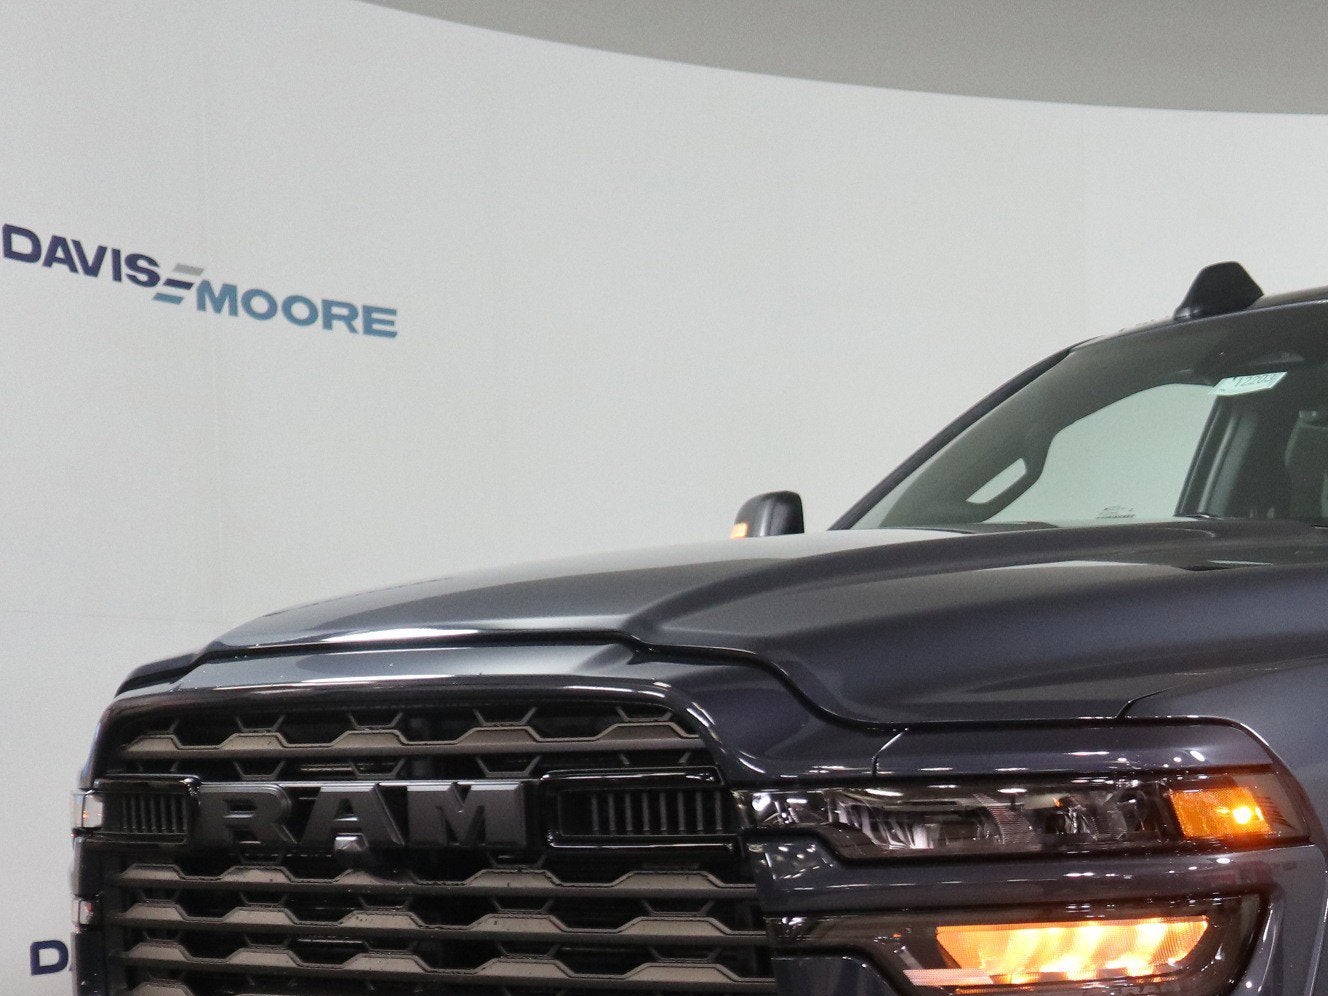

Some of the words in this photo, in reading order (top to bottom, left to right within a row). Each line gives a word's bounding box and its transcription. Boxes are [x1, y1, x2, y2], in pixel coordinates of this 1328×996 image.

[1, 223, 161, 288] DAVIS
[196, 279, 398, 338] MOORE
[198, 780, 528, 848] RAM
